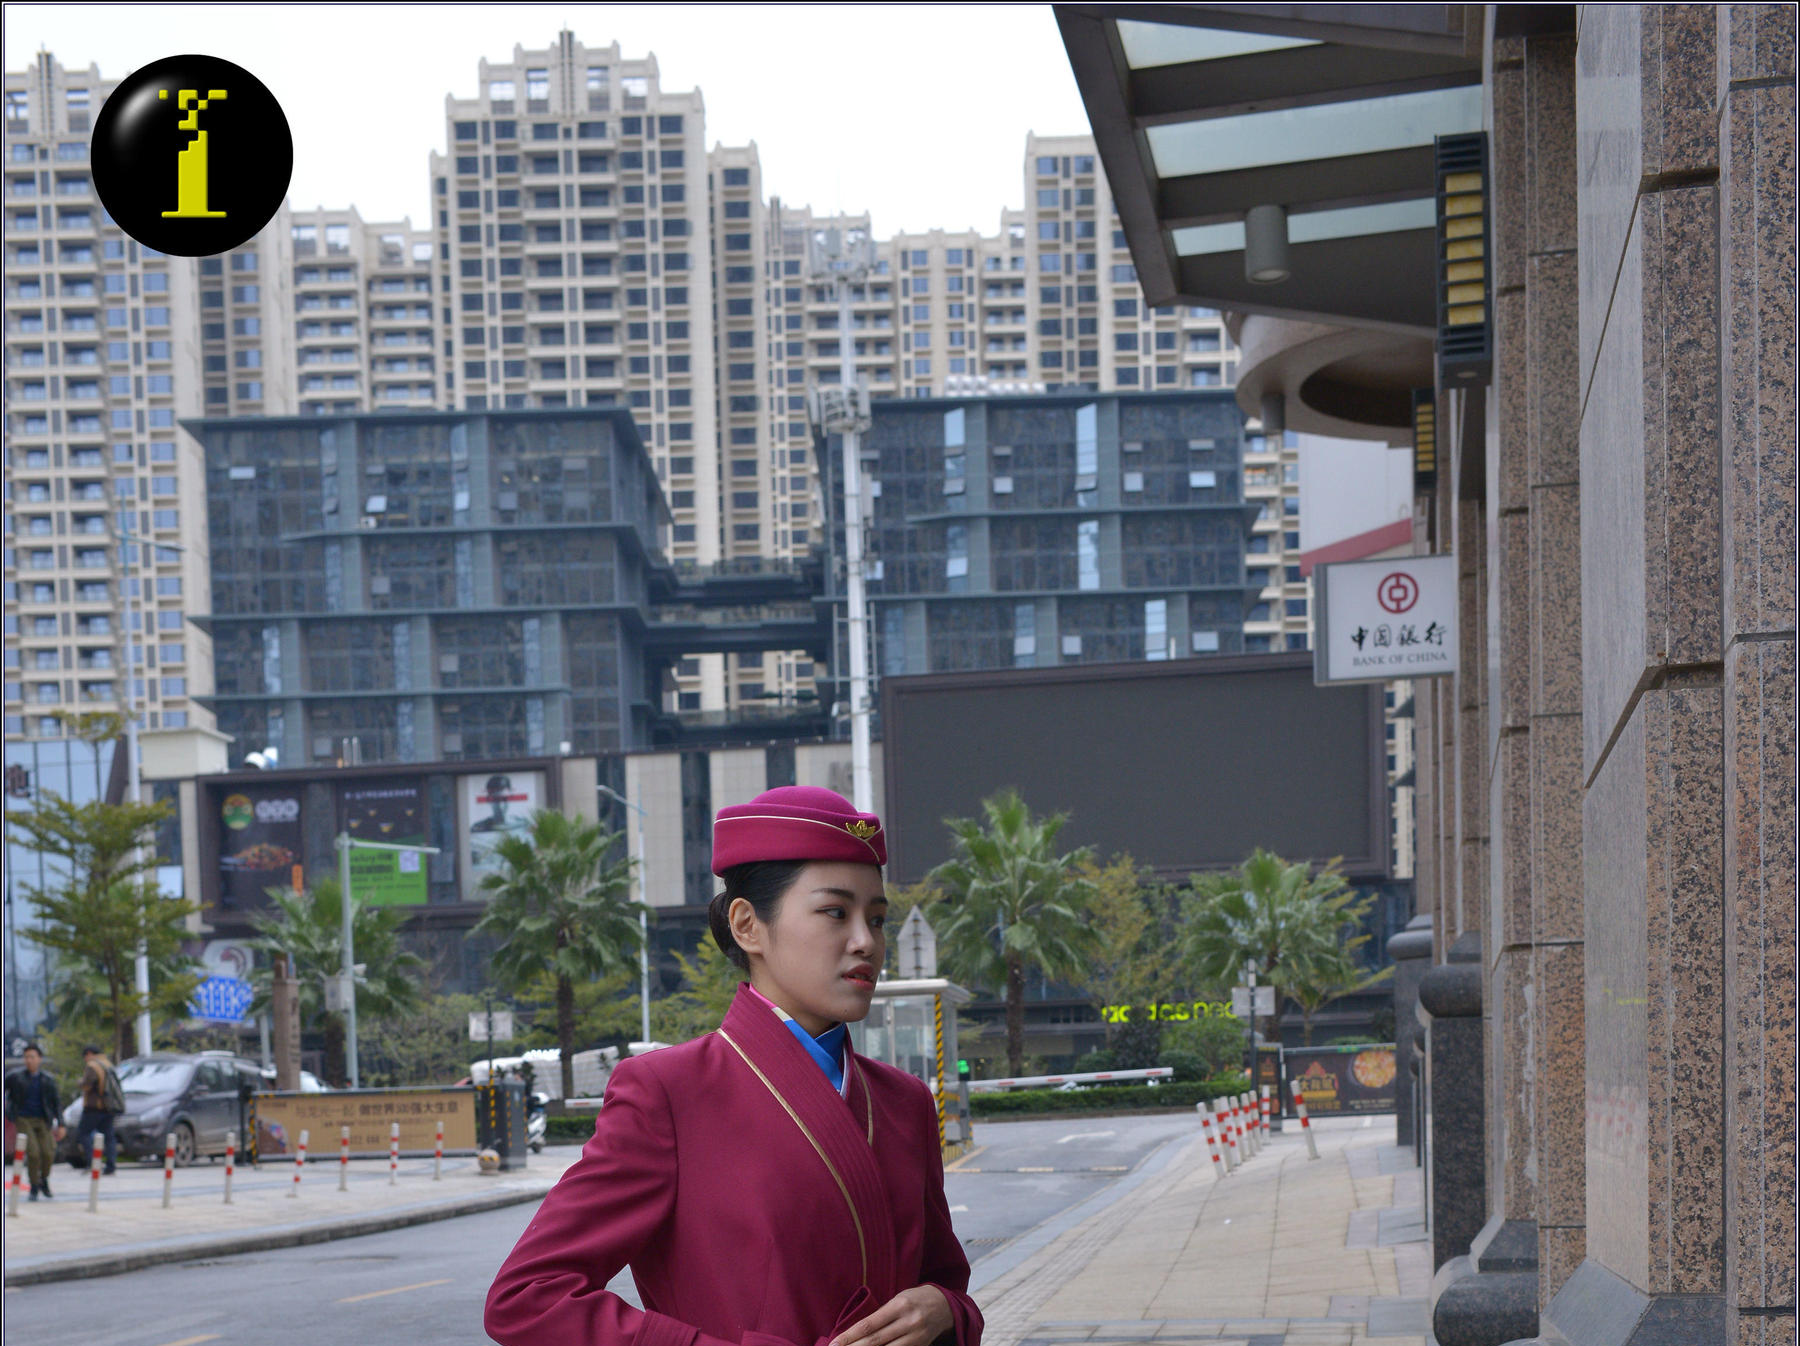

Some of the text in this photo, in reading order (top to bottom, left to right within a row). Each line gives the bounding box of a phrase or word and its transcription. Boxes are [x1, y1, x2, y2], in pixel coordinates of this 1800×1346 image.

[1352, 651, 1448, 667] BANK OF CHINA
